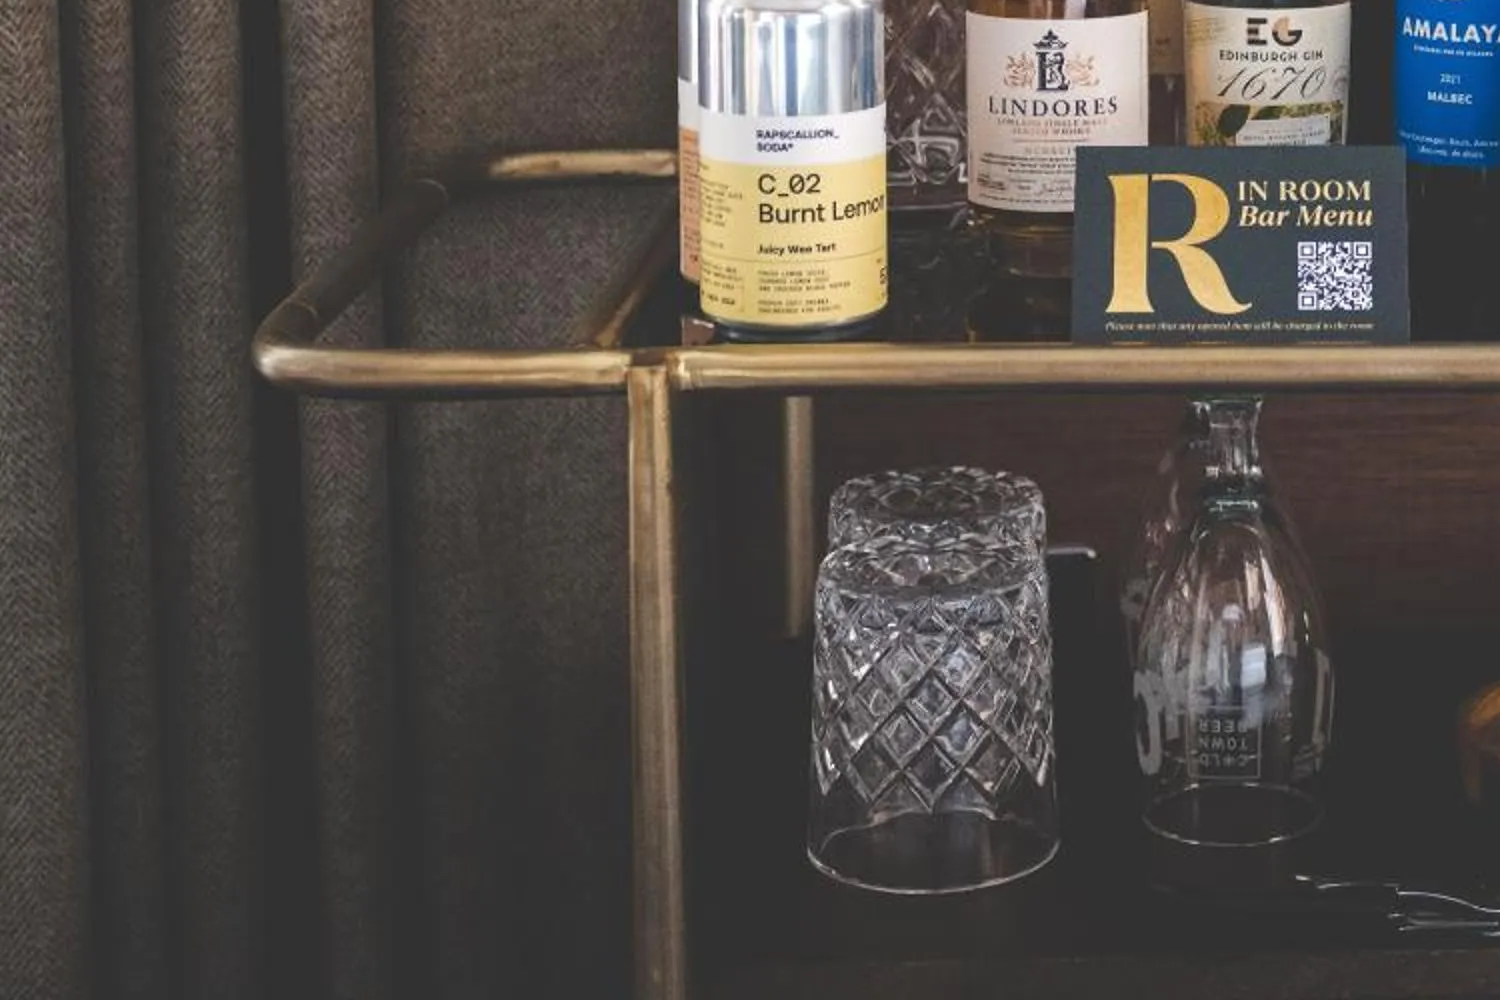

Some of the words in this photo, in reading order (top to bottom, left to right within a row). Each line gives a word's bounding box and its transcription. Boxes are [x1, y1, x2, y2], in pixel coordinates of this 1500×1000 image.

[1246, 16, 1303, 47] EG
[1219, 50, 1298, 62] EDINBURGH
[1303, 50, 1324, 61] GIN
[1216, 64, 1327, 101] 1670
[988, 96, 1118, 117] LINDORES
[1426, 91, 1473, 105] MALBEC
[1238, 179, 1268, 202] IN
[1278, 179, 1372, 202] ROOM
[758, 203, 826, 224] Burnt
[1238, 205, 1291, 228] Bar
[1297, 205, 1373, 228] Menu
[757, 245, 785, 257] Juicy
[788, 244, 813, 254] Wee
[816, 242, 837, 252] Tart
[1105, 172, 1252, 315] R
